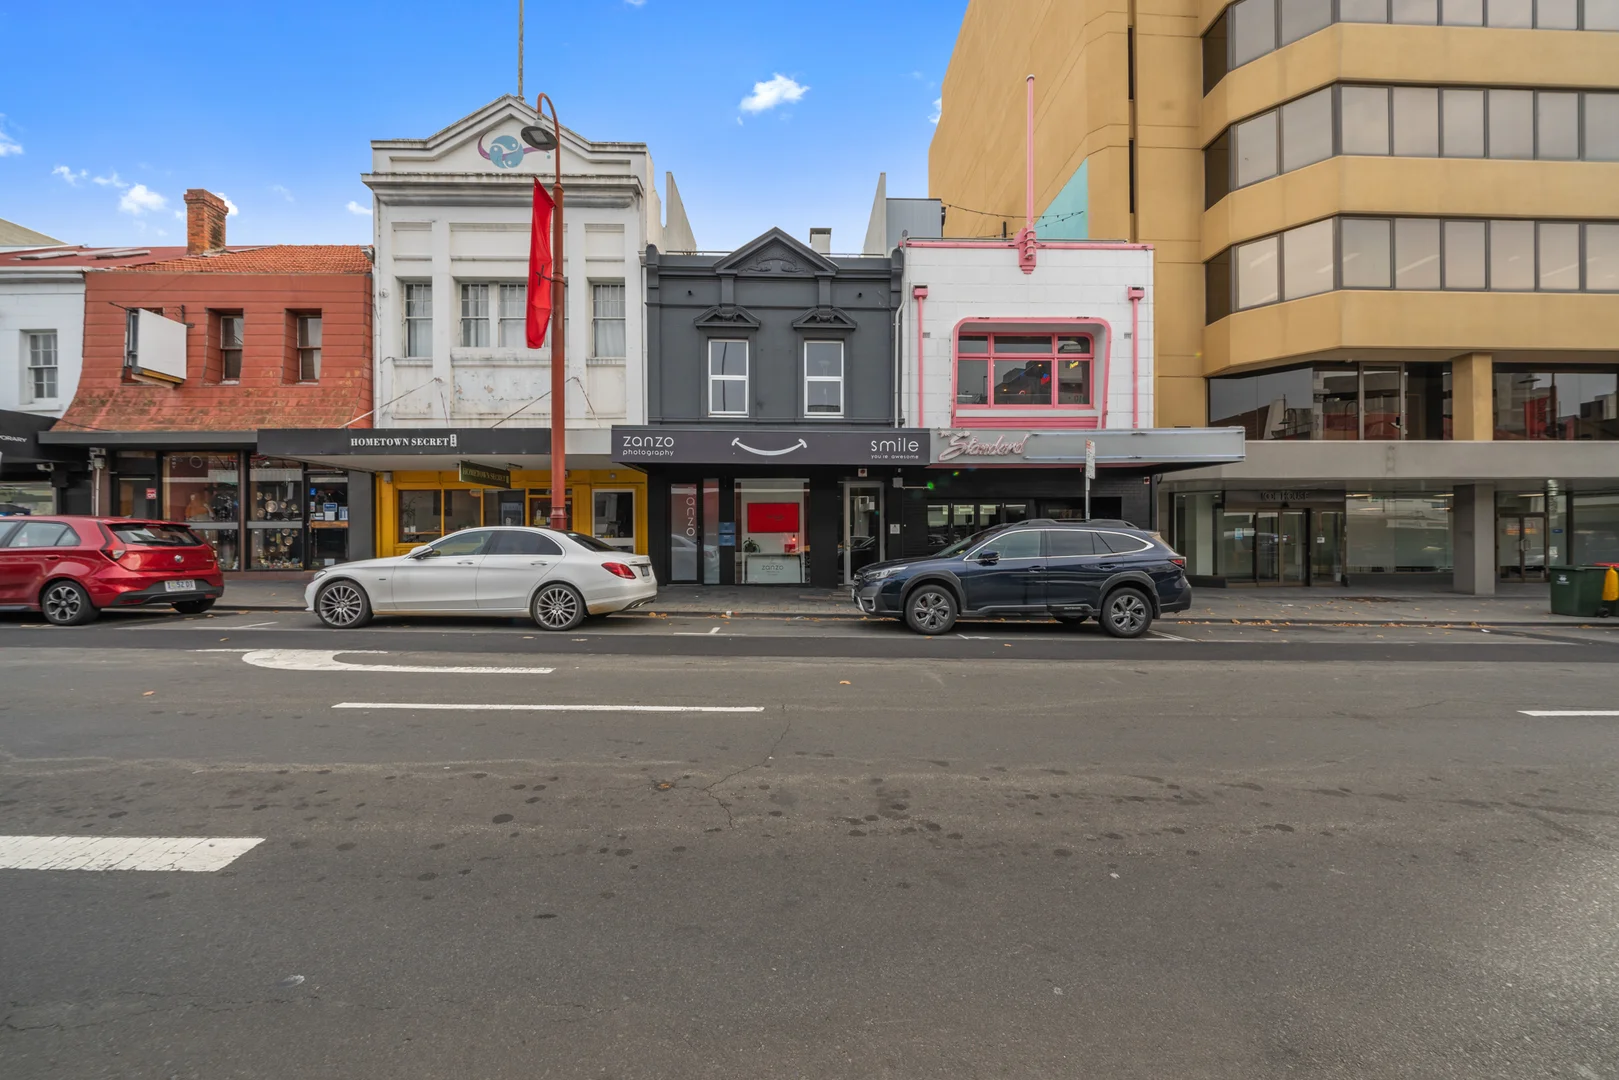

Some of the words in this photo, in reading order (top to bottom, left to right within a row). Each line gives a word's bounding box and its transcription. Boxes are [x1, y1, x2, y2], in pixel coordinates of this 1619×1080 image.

[0, 434, 27, 443] ORARY
[350, 438, 409, 446] HOMETOWN
[411, 438, 449, 446] SECRET
[622, 436, 674, 447] zanzo
[870, 437, 919, 452] smile
